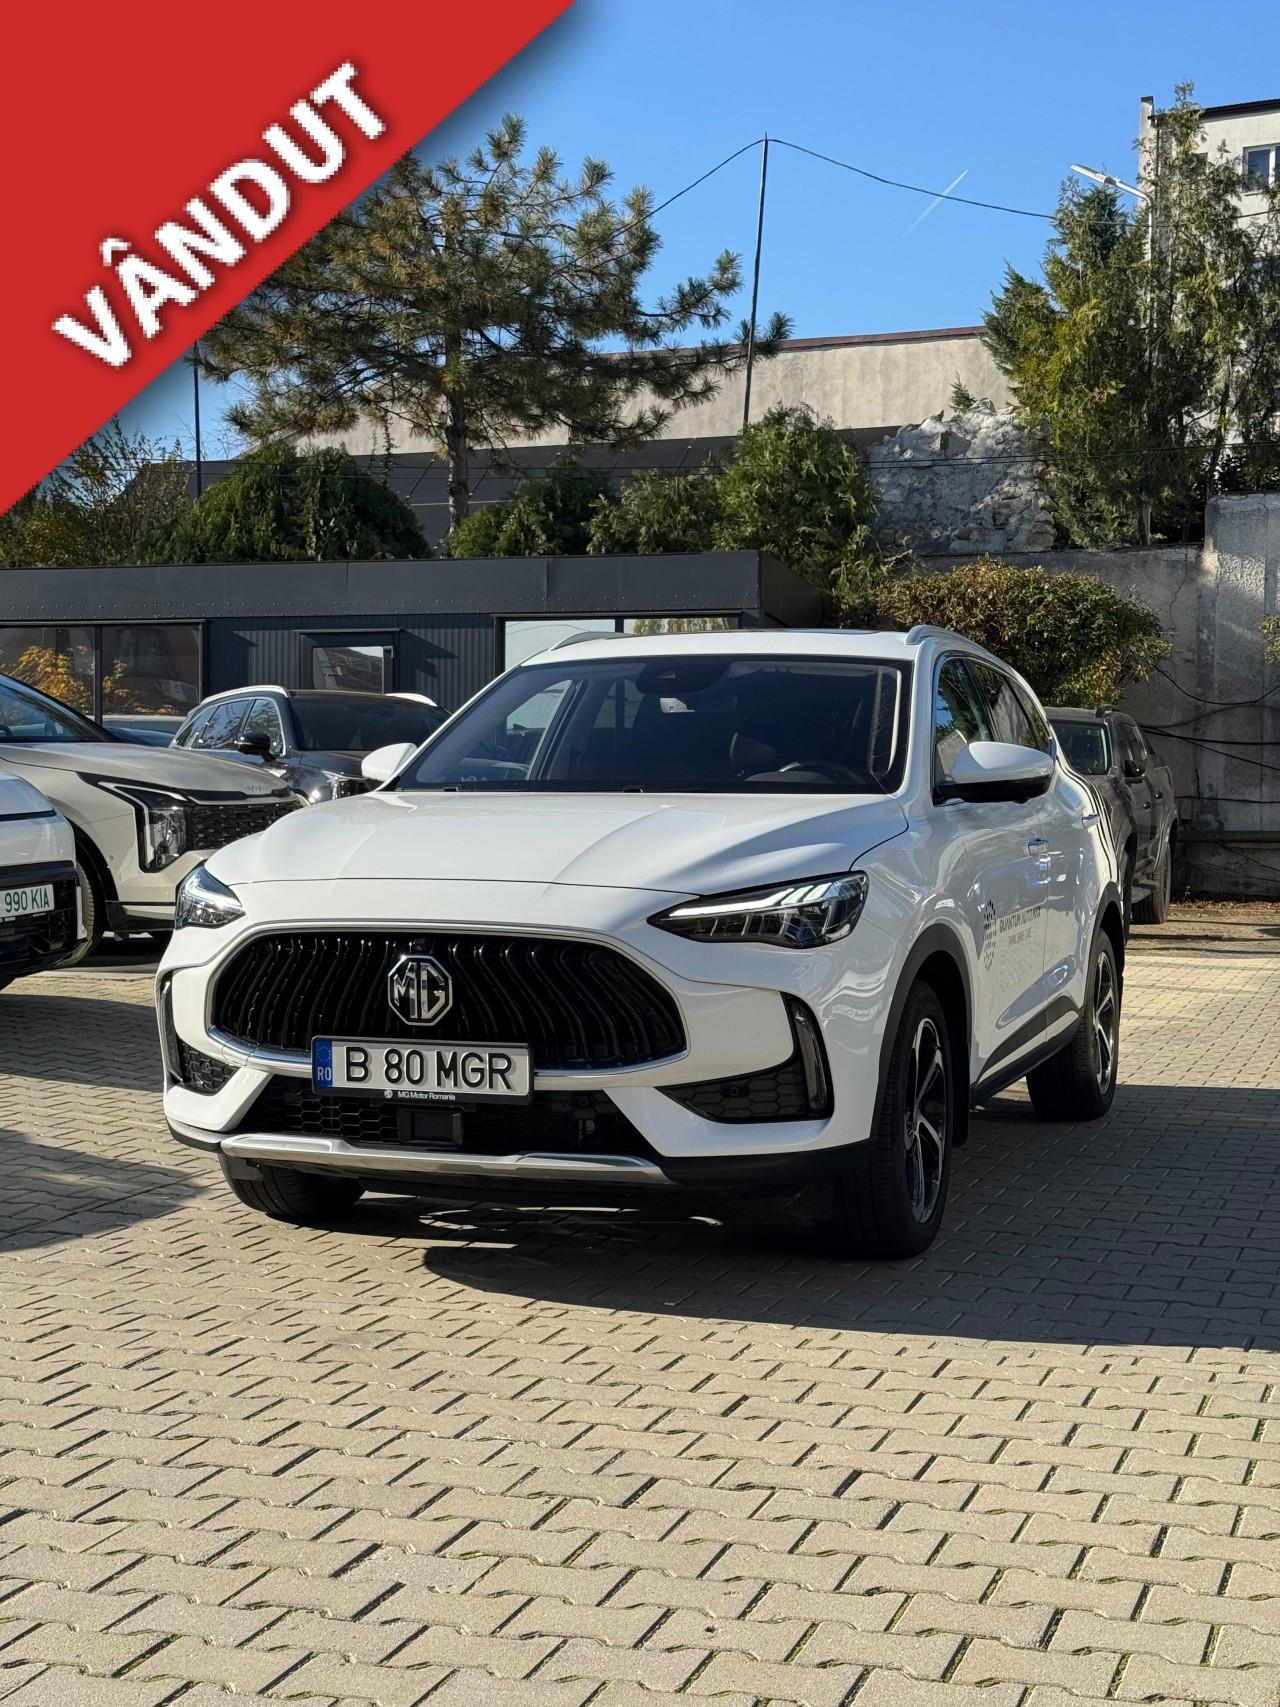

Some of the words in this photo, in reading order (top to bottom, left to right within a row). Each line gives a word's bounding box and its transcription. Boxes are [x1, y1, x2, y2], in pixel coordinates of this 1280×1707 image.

[5, 891, 28, 913] 990
[31, 888, 50, 910] KIA
[394, 962, 446, 1019] MG
[317, 1066, 332, 1081] RO
[345, 1046, 369, 1082] B
[385, 1048, 425, 1085] 80
[436, 1050, 513, 1090] MGR
[397, 1091, 410, 1099] MG
[411, 1091, 429, 1100] Motor
[428, 1092, 456, 1101] Romania
